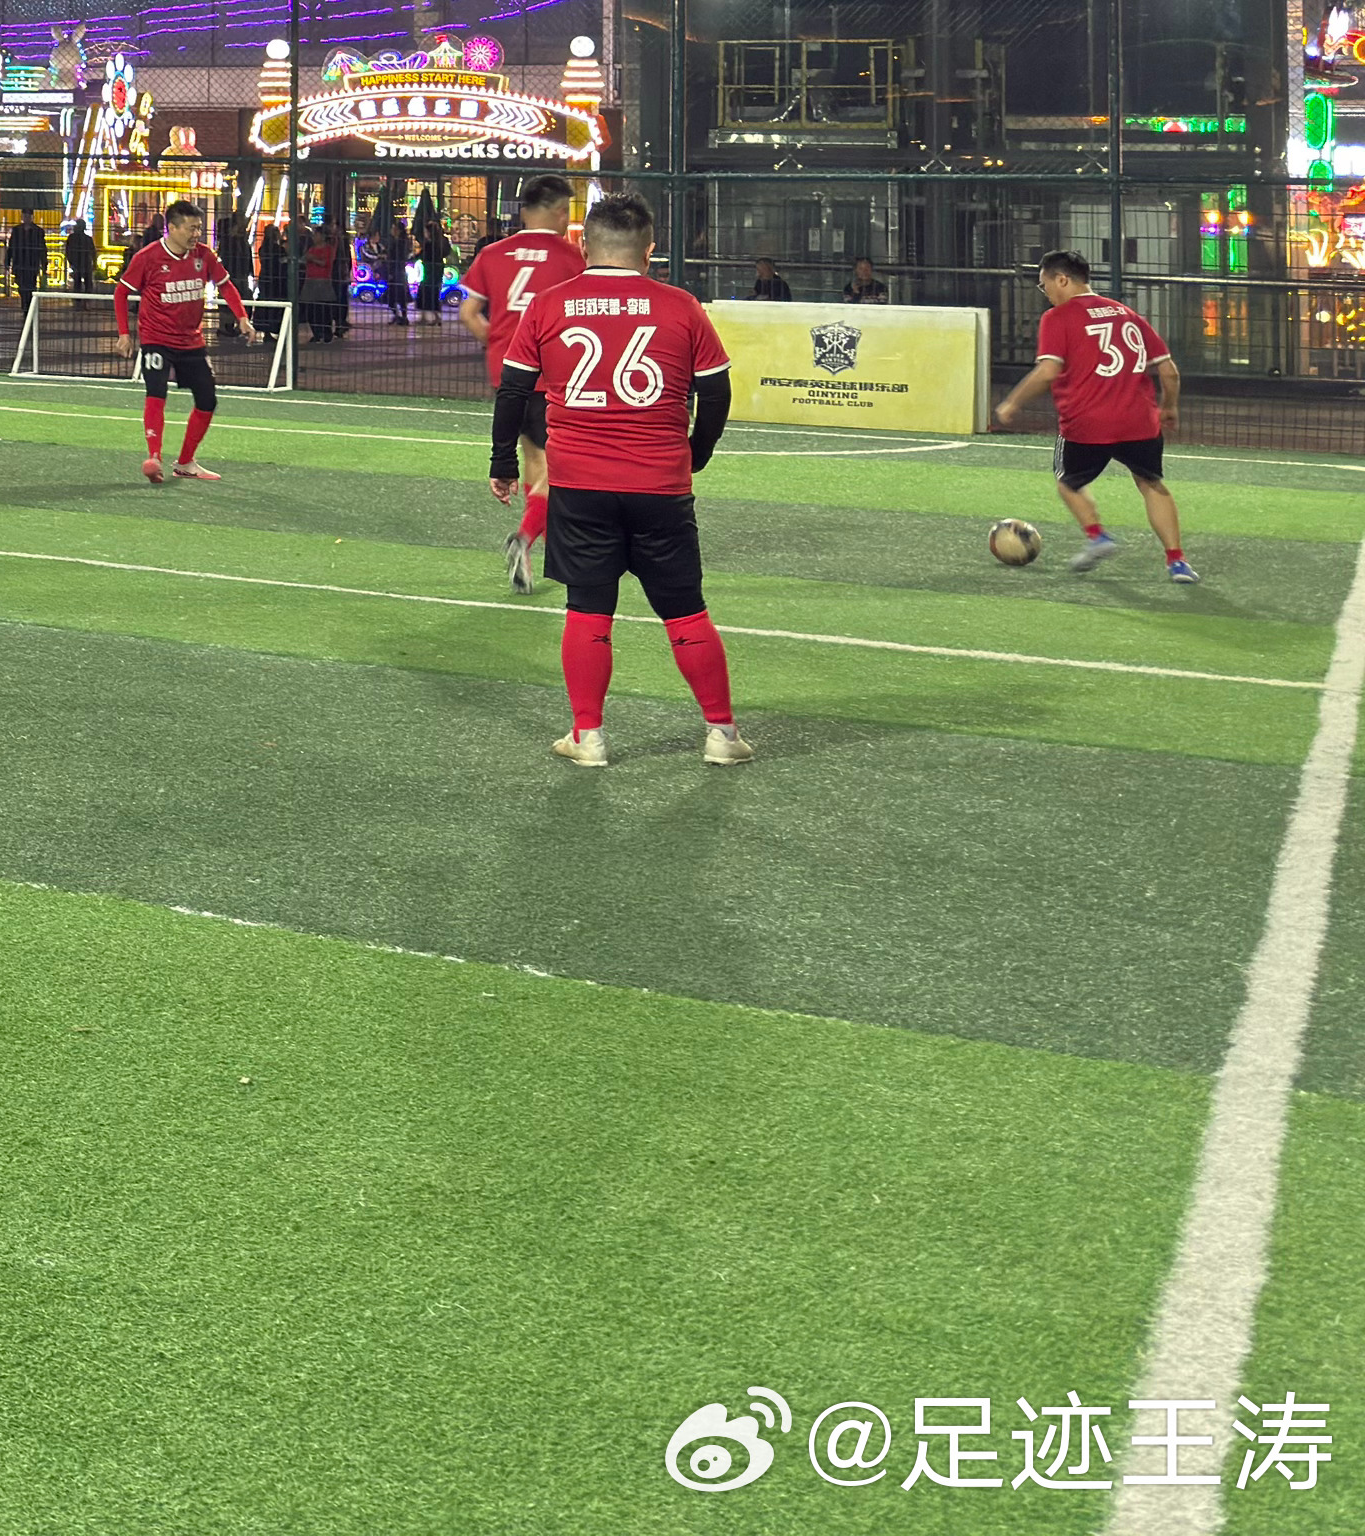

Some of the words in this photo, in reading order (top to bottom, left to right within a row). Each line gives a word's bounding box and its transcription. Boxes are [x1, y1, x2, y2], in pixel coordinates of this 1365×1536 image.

[360, 73, 419, 86] HAPPINESS
[420, 73, 455, 83] START
[458, 74, 486, 85] HERE
[404, 134, 442, 142] WELCOME
[374, 143, 499, 158] STARBUCKS
[1085, 321, 1148, 377] 39
[144, 352, 164, 370] 10
[559, 326, 664, 407] 26
[807, 390, 859, 400] QINYING
[792, 397, 844, 407] FOOTBALL
[847, 400, 874, 408] CLUB
